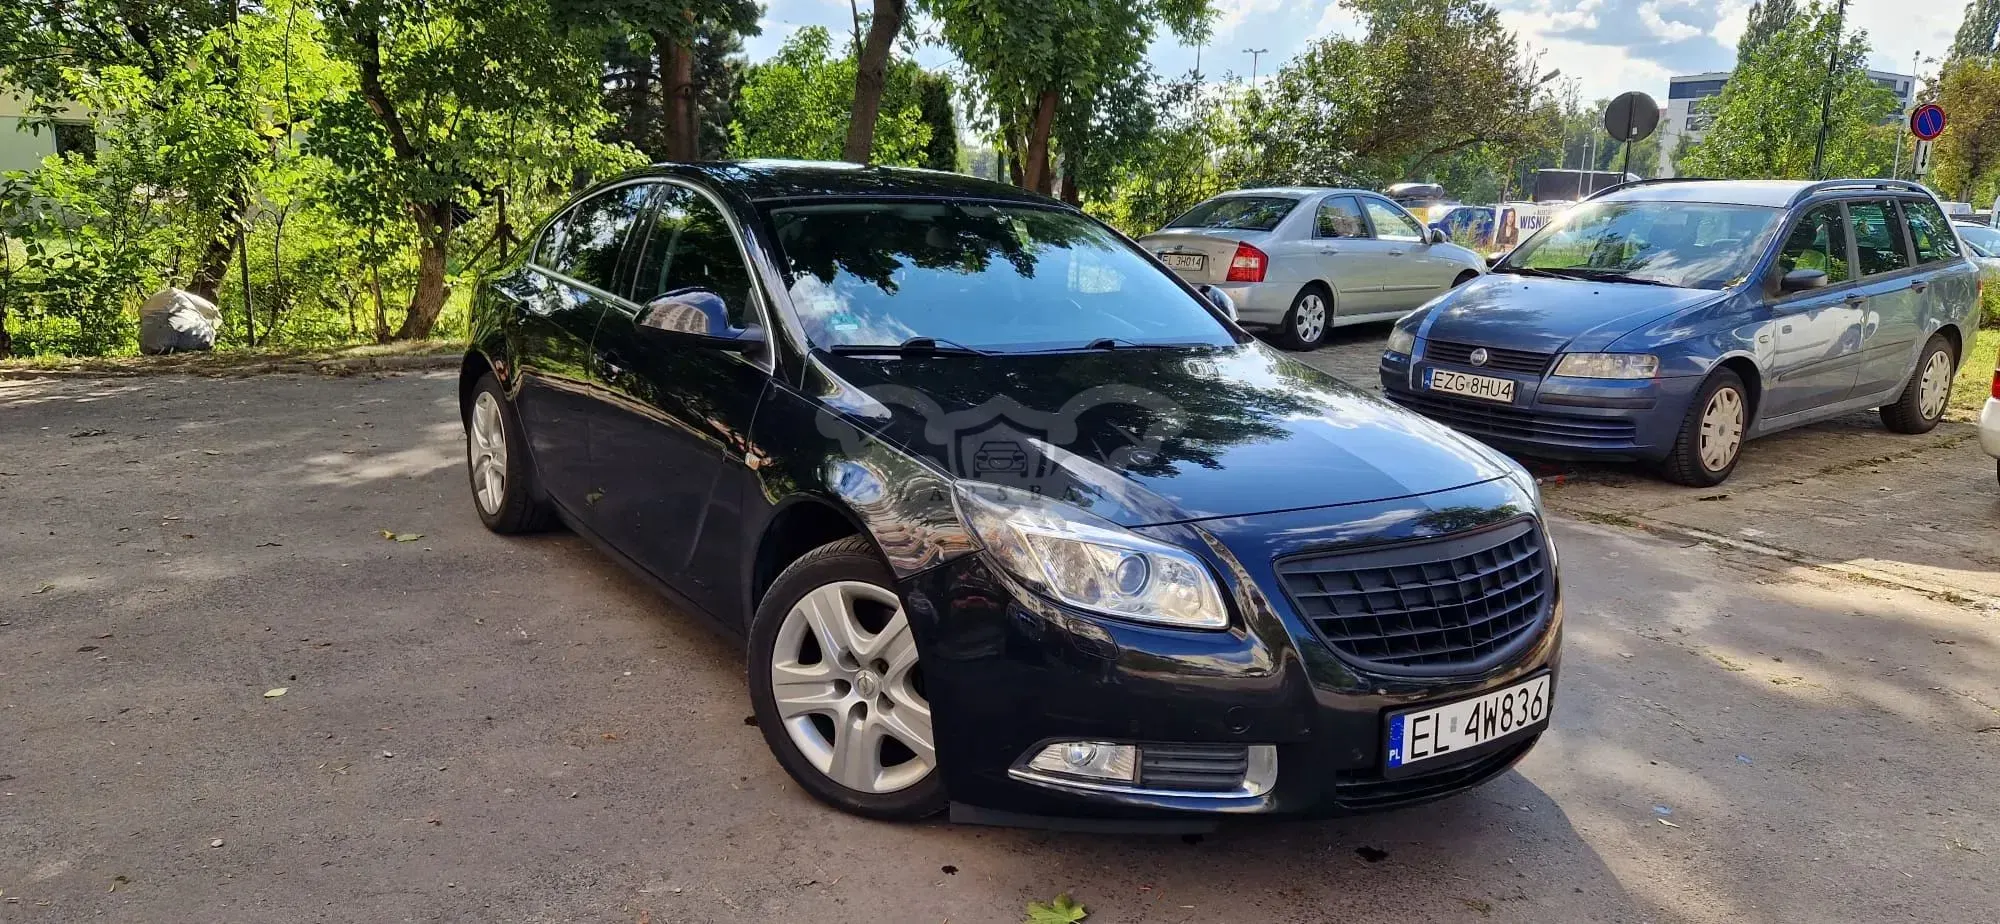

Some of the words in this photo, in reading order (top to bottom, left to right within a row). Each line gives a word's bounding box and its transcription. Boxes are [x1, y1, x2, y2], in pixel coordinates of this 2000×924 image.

[1434, 372, 1465, 391] EZG
[1470, 377, 1513, 400] 8HU4
[1411, 713, 1450, 760] EL
[1464, 681, 1544, 743] 4W836
[1389, 748, 1401, 761] PL
